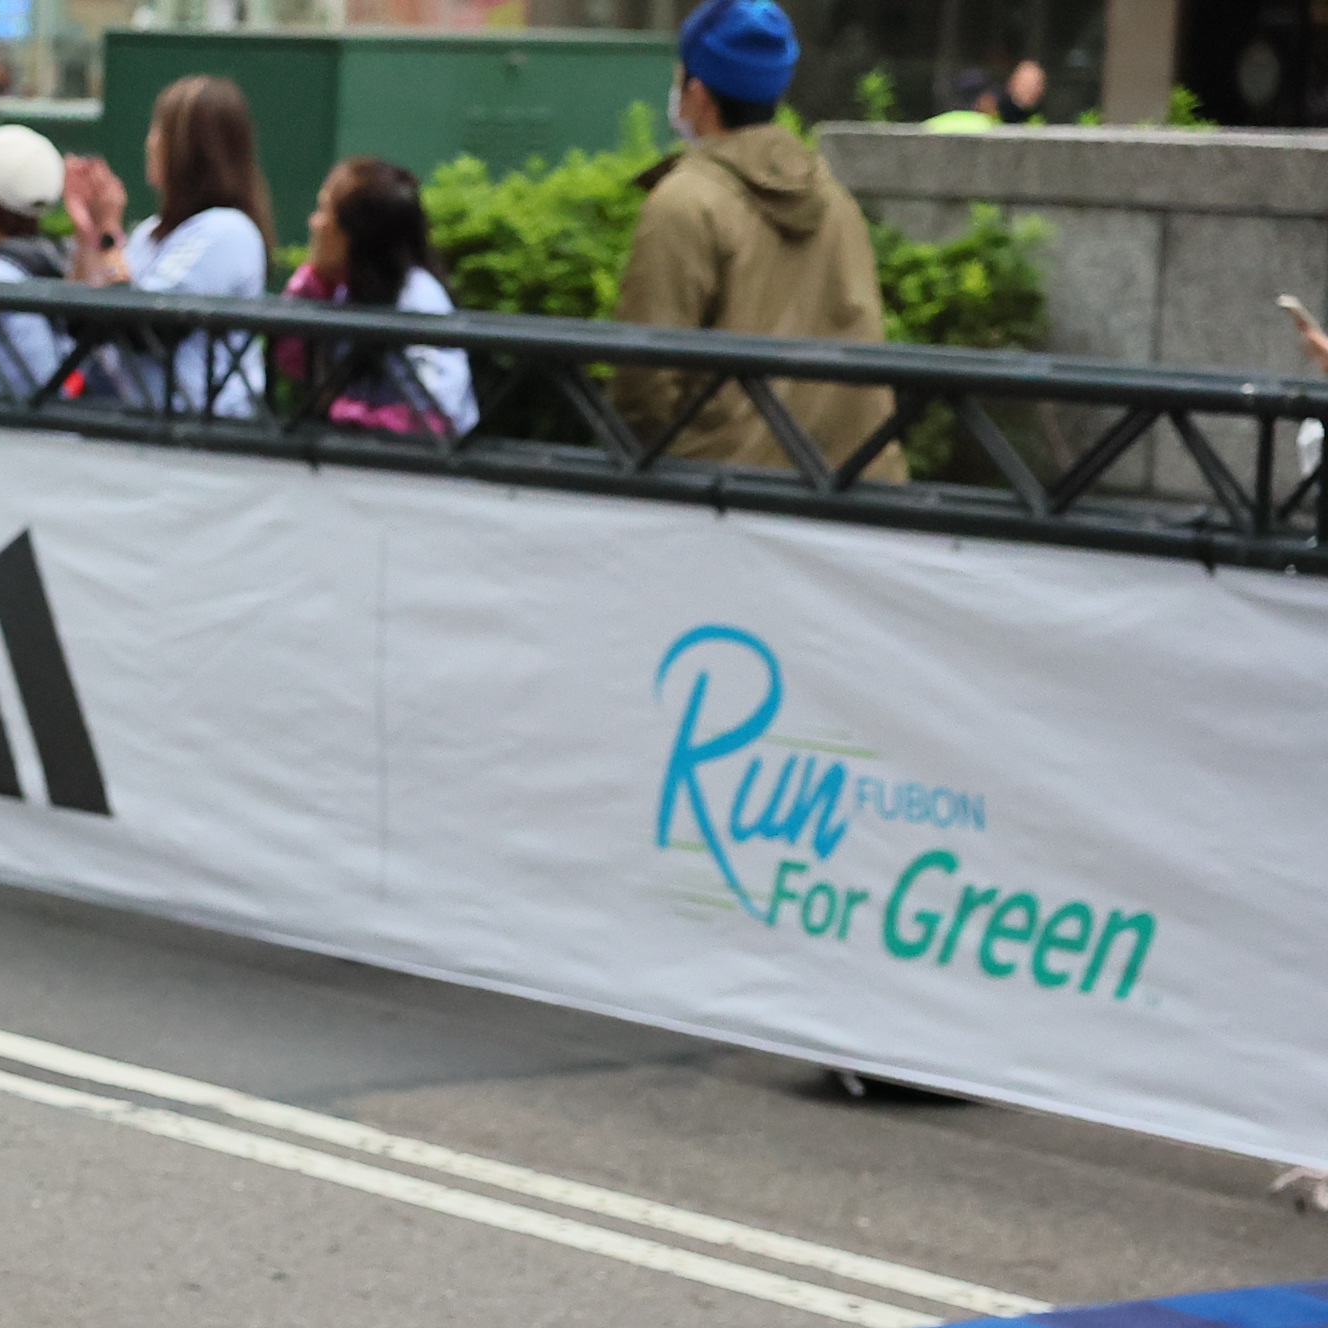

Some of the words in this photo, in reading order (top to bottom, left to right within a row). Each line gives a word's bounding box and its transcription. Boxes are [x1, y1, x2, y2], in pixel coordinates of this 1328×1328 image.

[655, 624, 849, 922] Run
[854, 775, 987, 833] FUBON
[767, 860, 870, 942] For
[881, 847, 1158, 1001] Green
